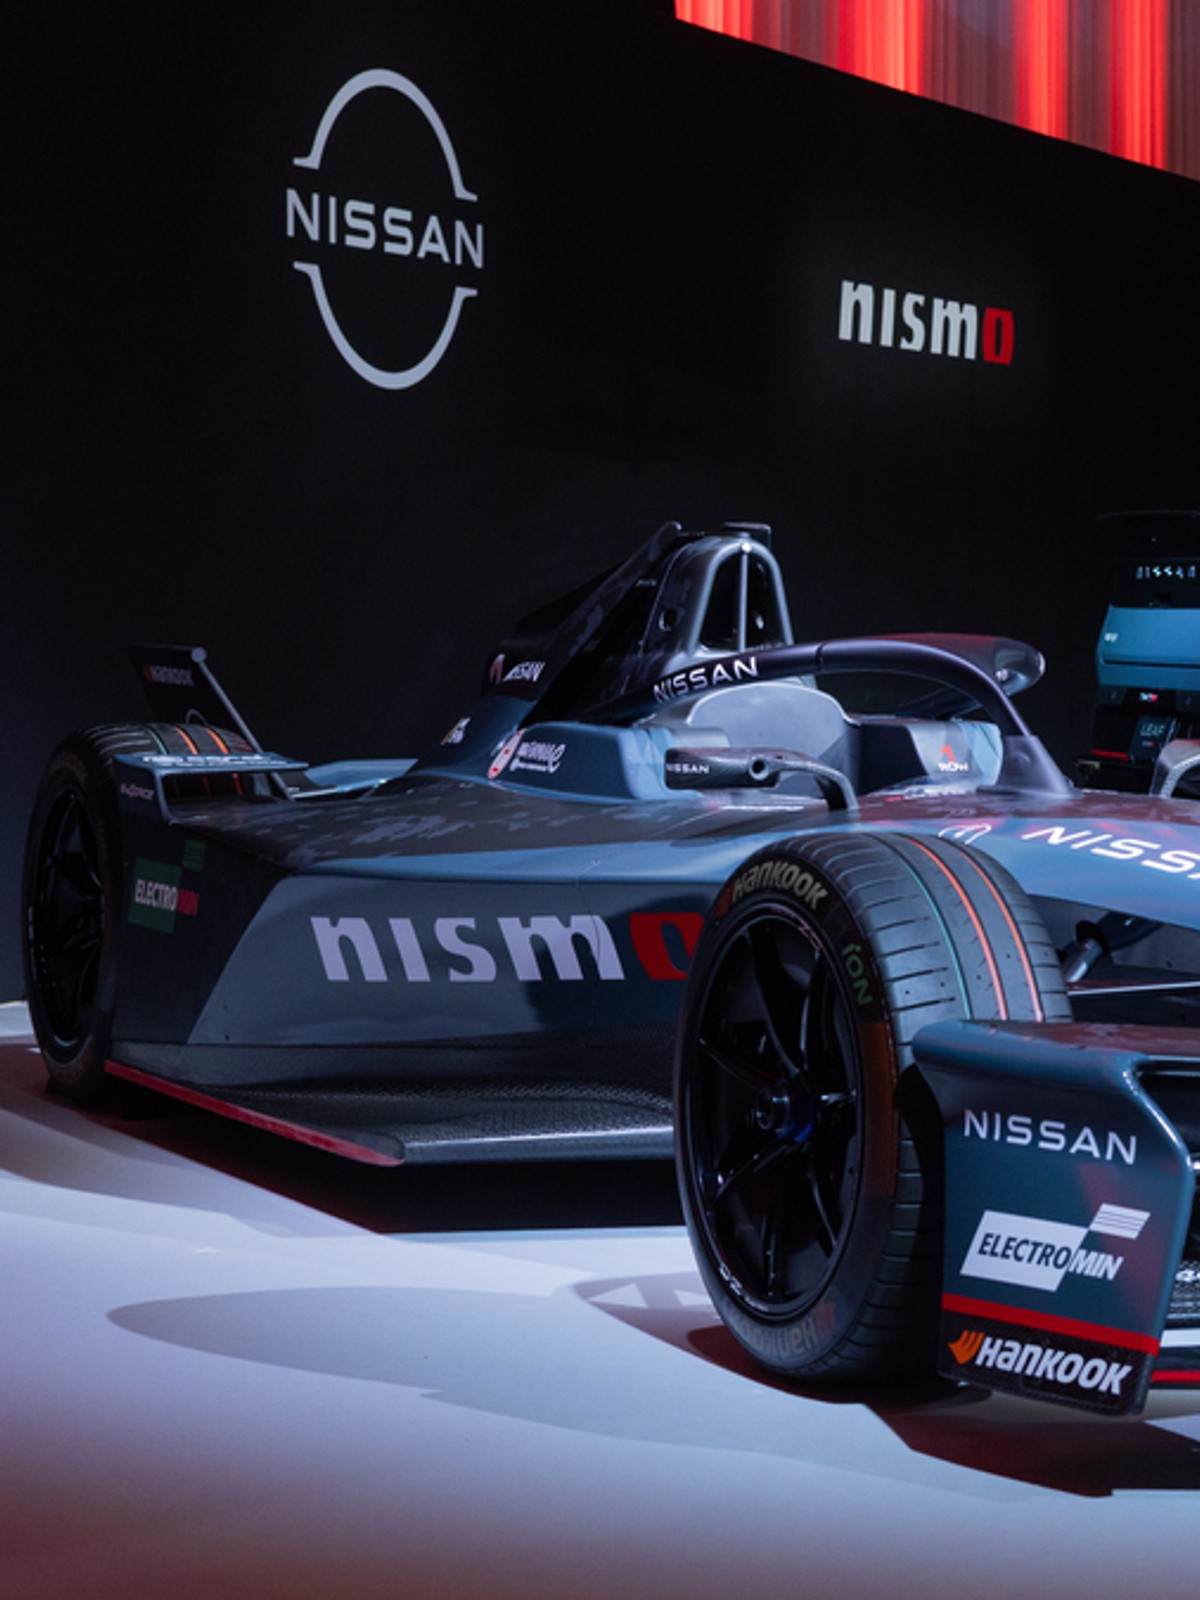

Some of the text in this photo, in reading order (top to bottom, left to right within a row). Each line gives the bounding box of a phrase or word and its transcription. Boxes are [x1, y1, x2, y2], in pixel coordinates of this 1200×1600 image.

[286, 187, 485, 269] NISSAN
[838, 279, 1015, 366] nismo
[652, 656, 760, 703] NISSAN
[310, 912, 704, 981] nismo
[963, 1109, 1137, 1165] NISSAN
[978, 1233, 1124, 1281] ELECTROMIN
